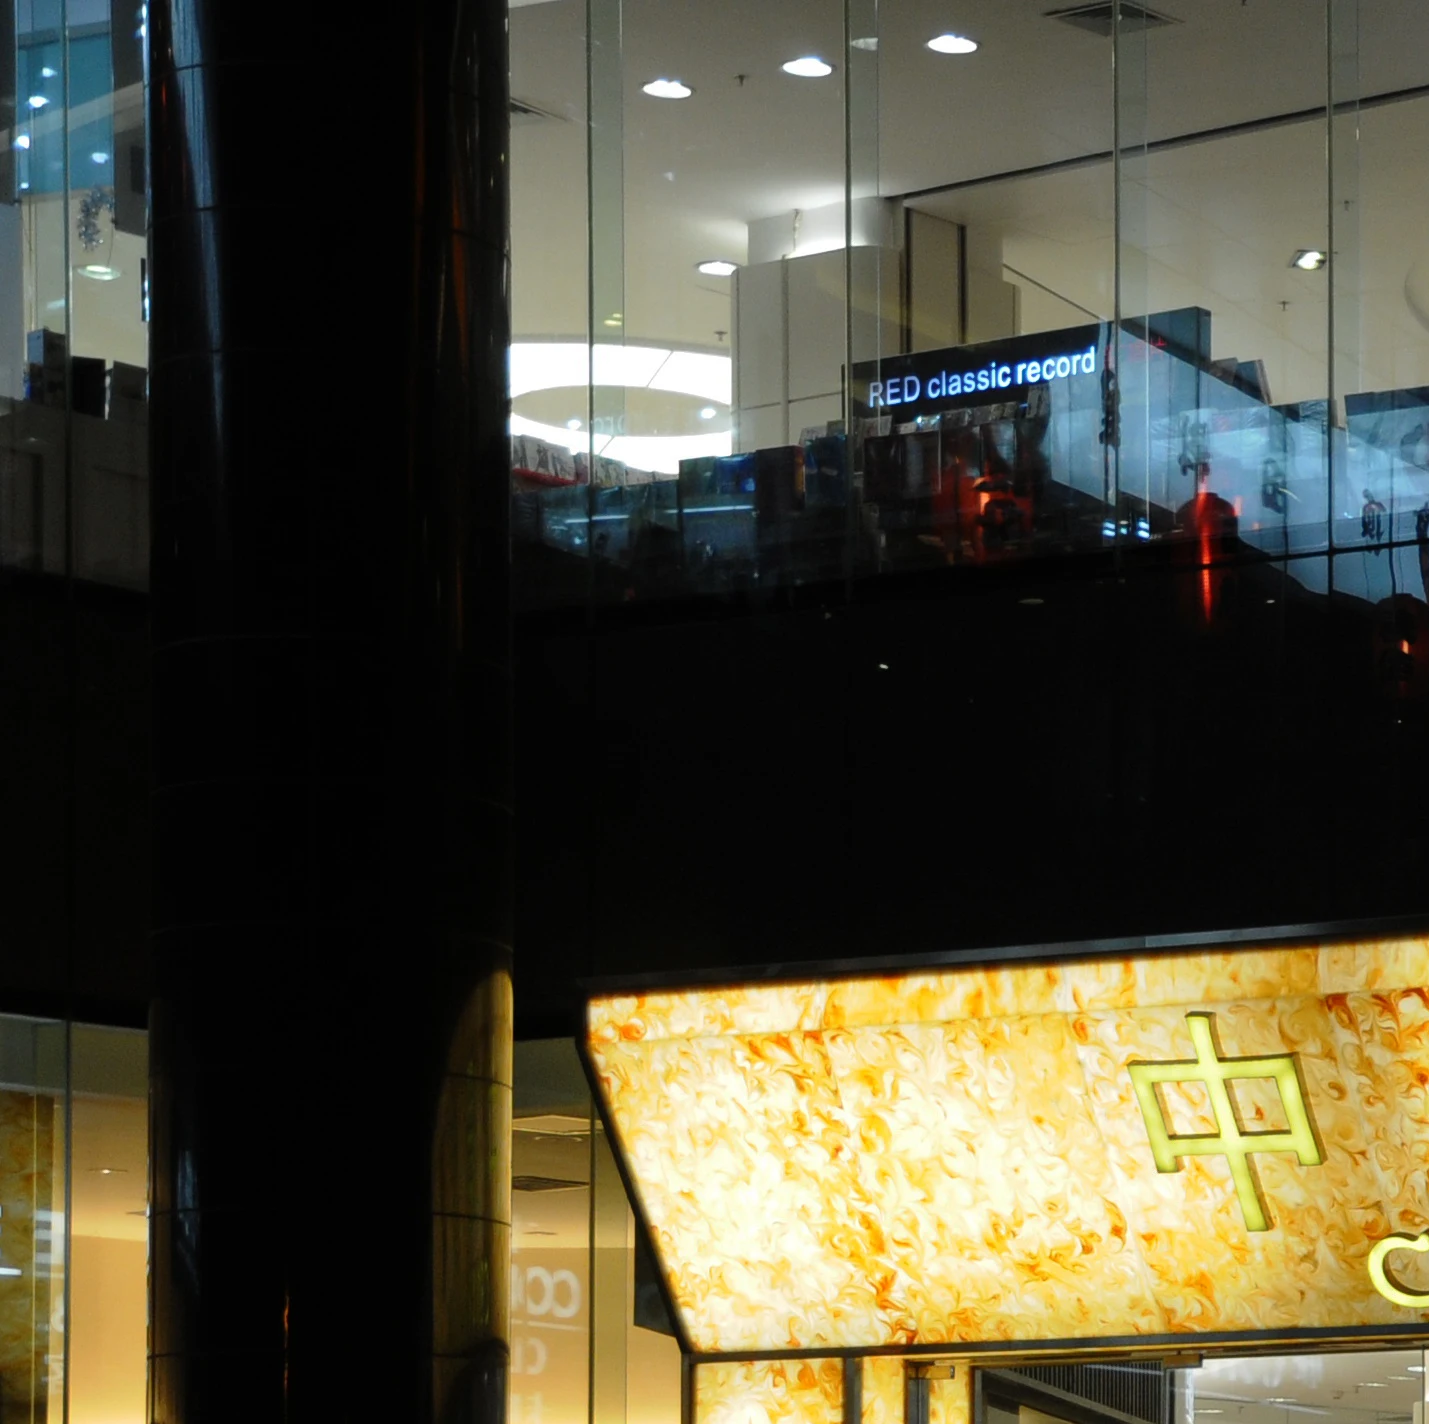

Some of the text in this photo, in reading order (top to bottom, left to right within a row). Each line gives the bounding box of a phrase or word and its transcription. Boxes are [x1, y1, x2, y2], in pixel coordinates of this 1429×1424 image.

[869, 345, 1096, 408] RED classic record
